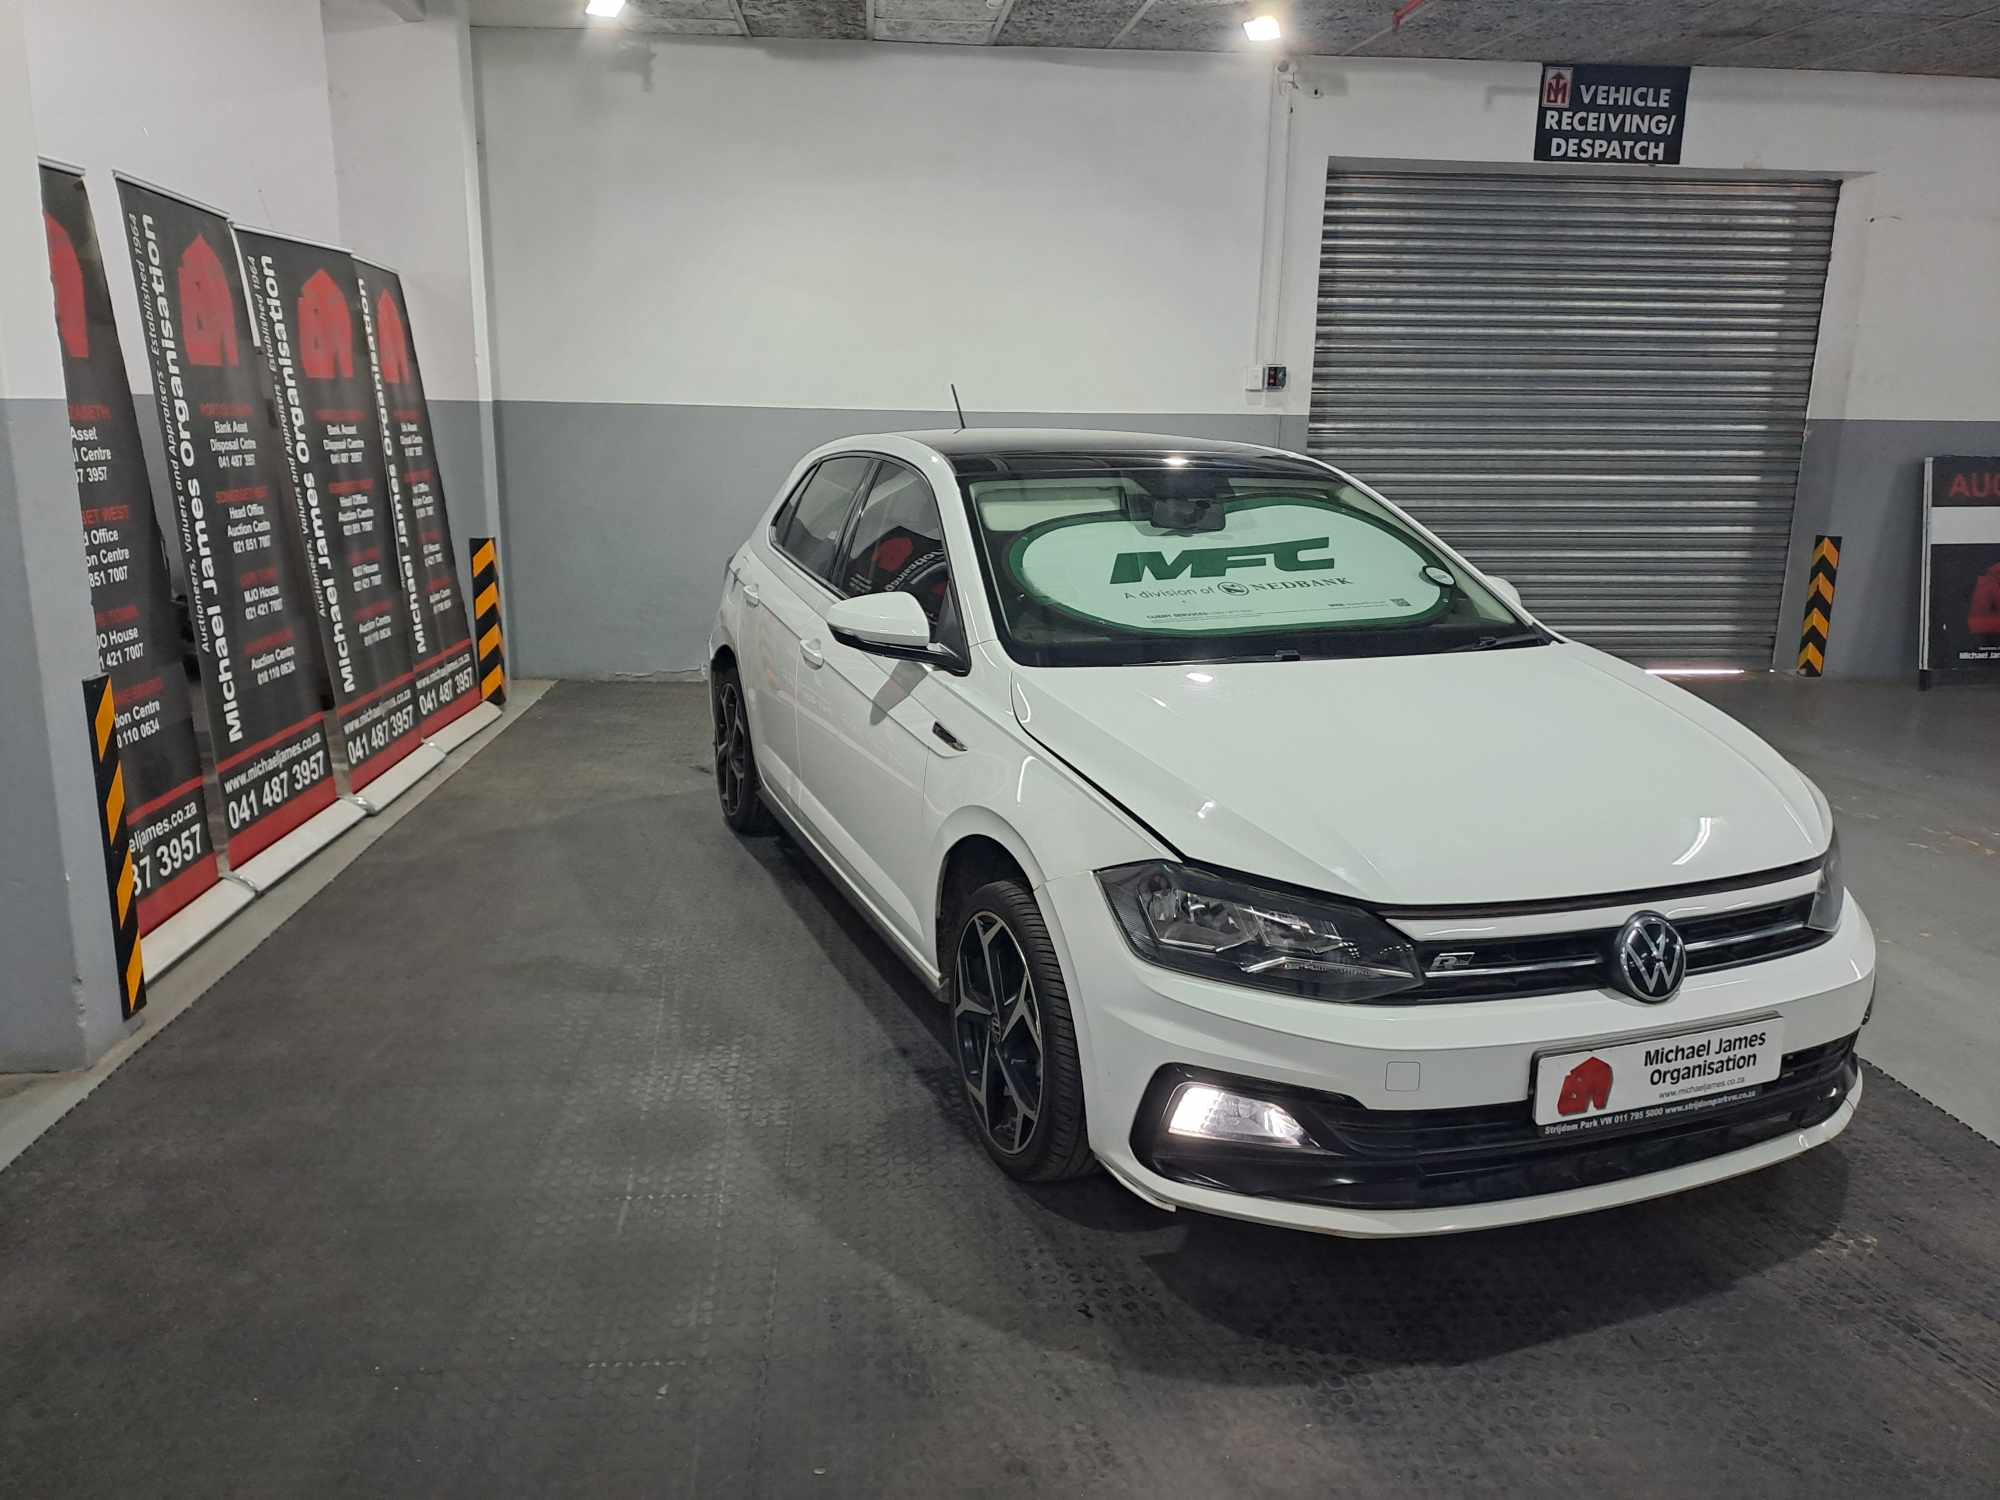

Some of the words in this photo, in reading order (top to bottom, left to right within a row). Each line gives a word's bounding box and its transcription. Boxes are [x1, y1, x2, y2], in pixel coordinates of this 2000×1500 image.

[1580, 84, 1671, 108] VEHICLE
[1544, 110, 1677, 135] RECEIVING/
[1550, 137, 1665, 161] DESPATCH
[128, 212, 142, 255] 1964
[135, 259, 160, 356] Established
[142, 214, 195, 468] Organisation
[260, 255, 310, 464] Organisation
[358, 278, 392, 456] Organisation
[157, 370, 177, 456] Appraisers
[70, 426, 98, 440] Asset
[210, 438, 239, 453] Disposal
[80, 447, 112, 461] Centre
[87, 466, 108, 482] 3957
[170, 459, 183, 490] and
[303, 472, 333, 570] James
[388, 464, 409, 547] James
[91, 528, 119, 545] Office
[187, 478, 218, 596] James
[100, 548, 130, 564] Centre
[1110, 536, 1335, 584] MFC
[88, 569, 106, 588] 851
[108, 565, 129, 583] 7007
[1124, 592, 1136, 601] A
[1138, 587, 1197, 600] division
[1200, 585, 1217, 596] of
[1251, 577, 1353, 592] NEDBANK
[402, 555, 427, 654] Michael
[109, 627, 139, 645] House
[322, 578, 356, 693] Michael
[106, 650, 122, 667] 421
[124, 642, 144, 661] 7007
[206, 604, 243, 743] Michael
[419, 689, 438, 715] 041
[439, 679, 453, 703] 487
[454, 667, 473, 693] 3957
[132, 700, 161, 720] Centre
[123, 727, 139, 745] 110
[140, 717, 160, 738] 0634
[348, 732, 370, 764] 041
[371, 720, 390, 749] 487
[390, 704, 413, 737] 3957
[224, 732, 321, 794] www.michaeljames.co.za
[228, 789, 259, 829] 041
[262, 771, 288, 807] 487
[292, 750, 324, 790] 3957
[156, 823, 202, 878] 3957
[1644, 1039, 1711, 1067] Michael
[1715, 1032, 1766, 1054] James
[1650, 1053, 1757, 1085] Organisation
[1580, 1118, 1598, 1129] Park
[1600, 1116, 1613, 1126] VW
